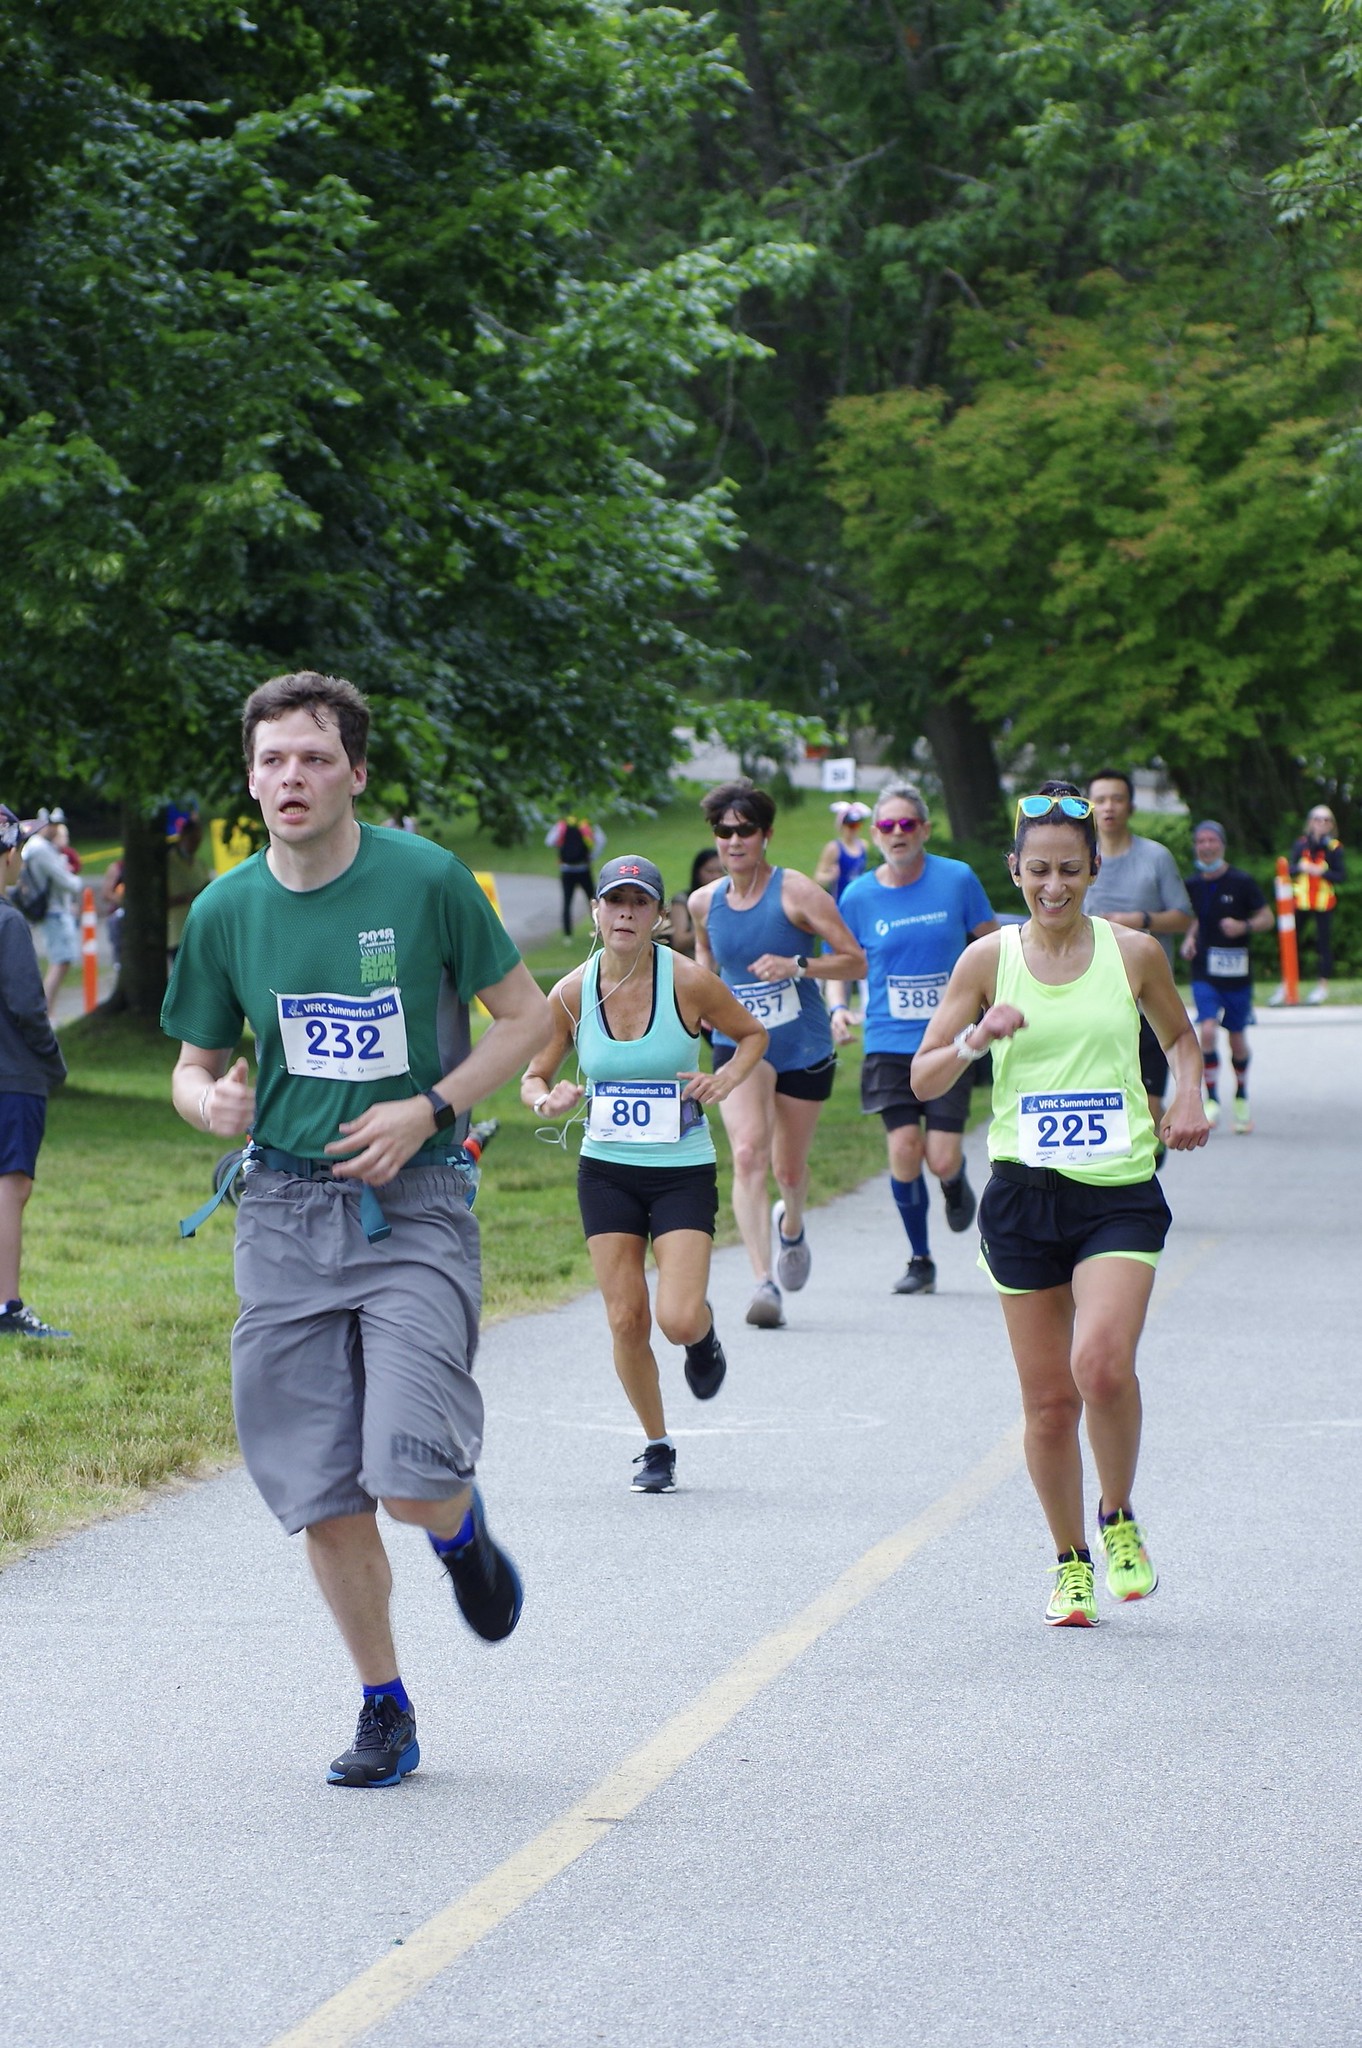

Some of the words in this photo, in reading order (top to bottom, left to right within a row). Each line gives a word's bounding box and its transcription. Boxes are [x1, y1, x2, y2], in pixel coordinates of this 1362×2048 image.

[358, 928, 395, 945] 2018
[361, 953, 396, 968] SUN
[361, 965, 397, 983] RUN
[898, 989, 938, 1008] 388
[303, 1002, 328, 1013] VFAC
[328, 1003, 375, 1018] Summerfast
[377, 1002, 394, 1015] 10k
[305, 1020, 385, 1060] 232
[660, 1087, 673, 1095] 10k
[1038, 1099, 1059, 1109] VFAC
[1060, 1097, 1104, 1108] Summerfast
[1105, 1097, 1119, 1107] 10k
[612, 1099, 651, 1127] 80
[1037, 1113, 1108, 1148] 225
